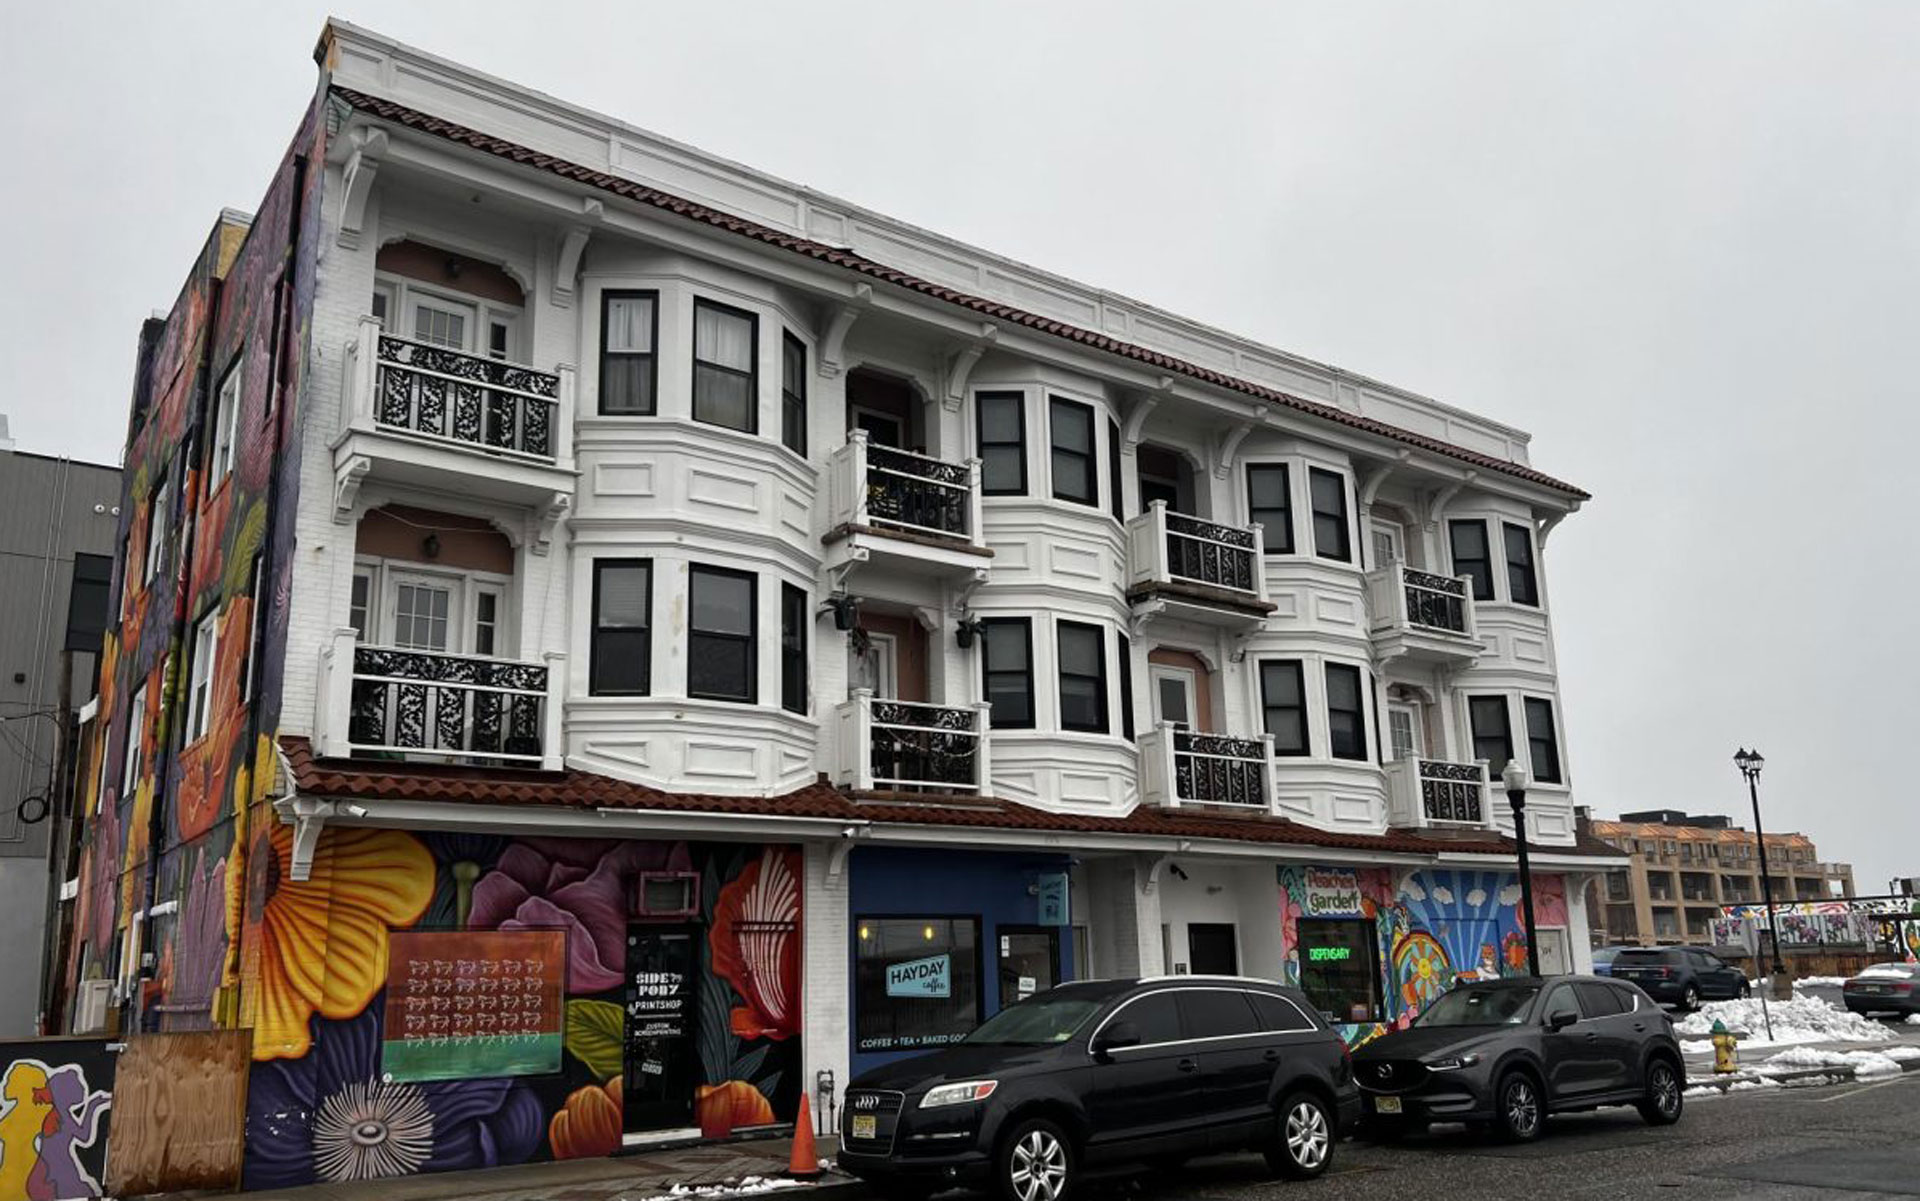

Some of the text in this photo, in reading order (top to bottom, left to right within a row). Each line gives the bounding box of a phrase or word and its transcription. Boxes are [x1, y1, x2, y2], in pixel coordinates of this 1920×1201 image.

[1309, 947, 1350, 960] DISPENSARY
[636, 972, 669, 984] SIDE
[891, 960, 945, 985] HAYDAY
[639, 985, 679, 996] PONY
[922, 977, 946, 993] coffee
[635, 1000, 682, 1010] PRINTSHOP
[861, 1038, 892, 1048] COFFEE
[900, 1036, 915, 1046] TEA
[922, 1035, 948, 1045] BAKED
